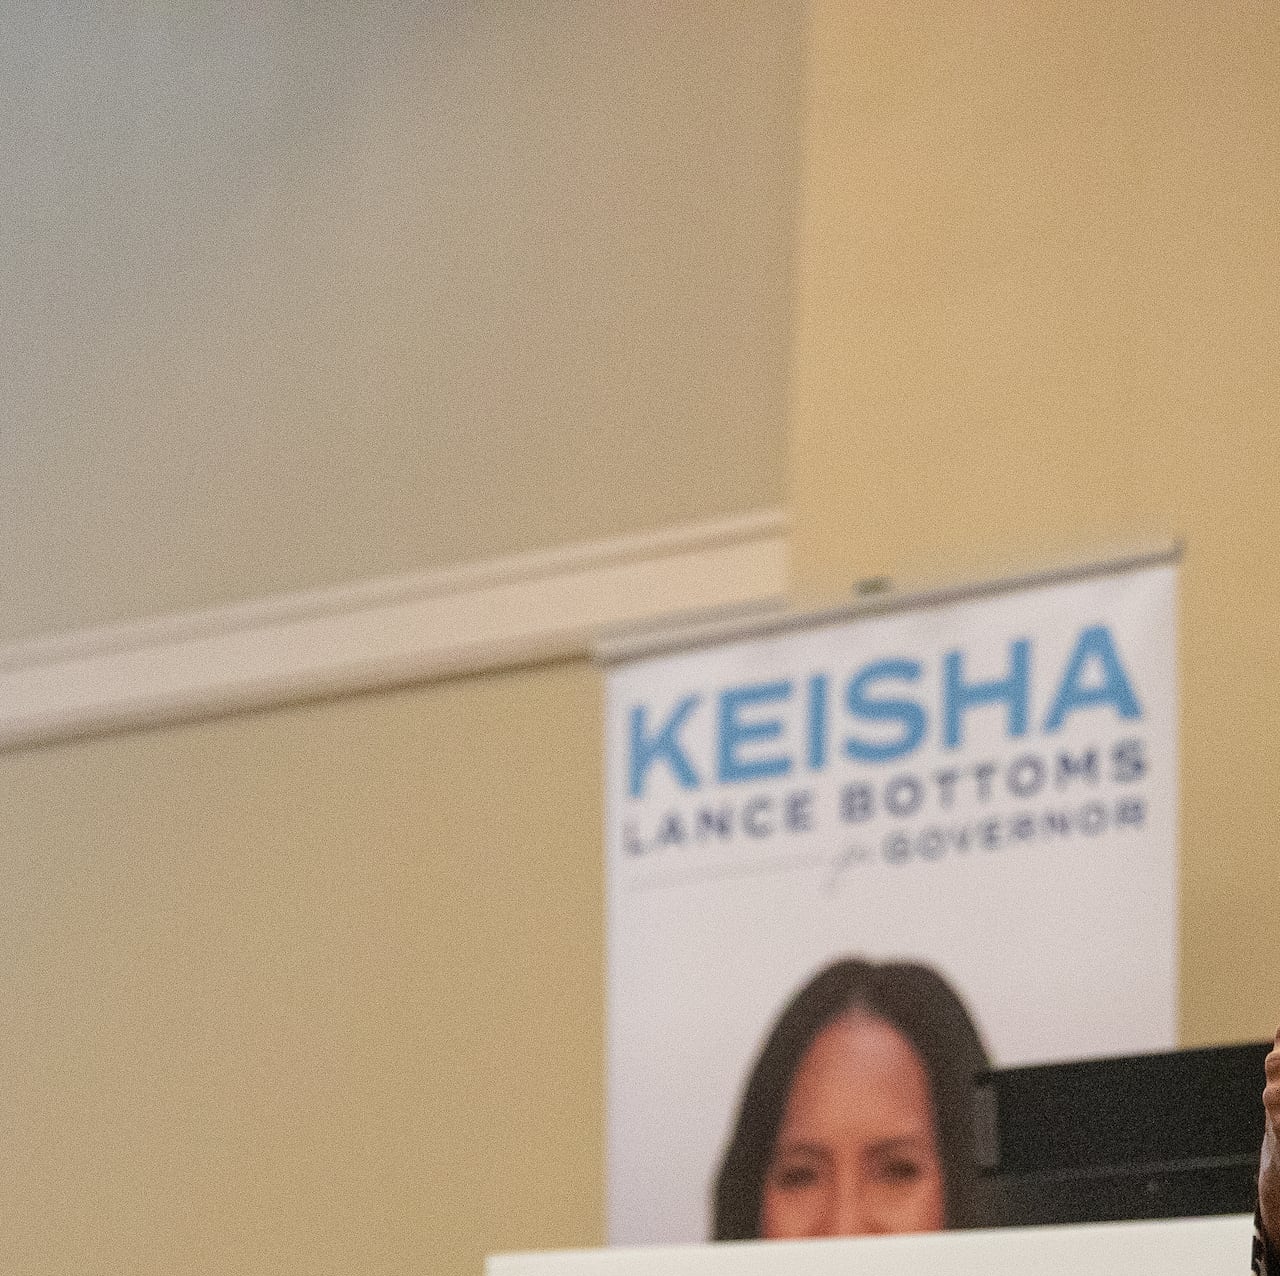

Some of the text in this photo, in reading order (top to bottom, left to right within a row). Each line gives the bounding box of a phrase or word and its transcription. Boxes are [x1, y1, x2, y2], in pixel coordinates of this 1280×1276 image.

[628, 624, 1144, 798] KEISHA
[625, 738, 1147, 857] LANCE BOTTOMS
[882, 797, 1146, 866] GOVERNOR
